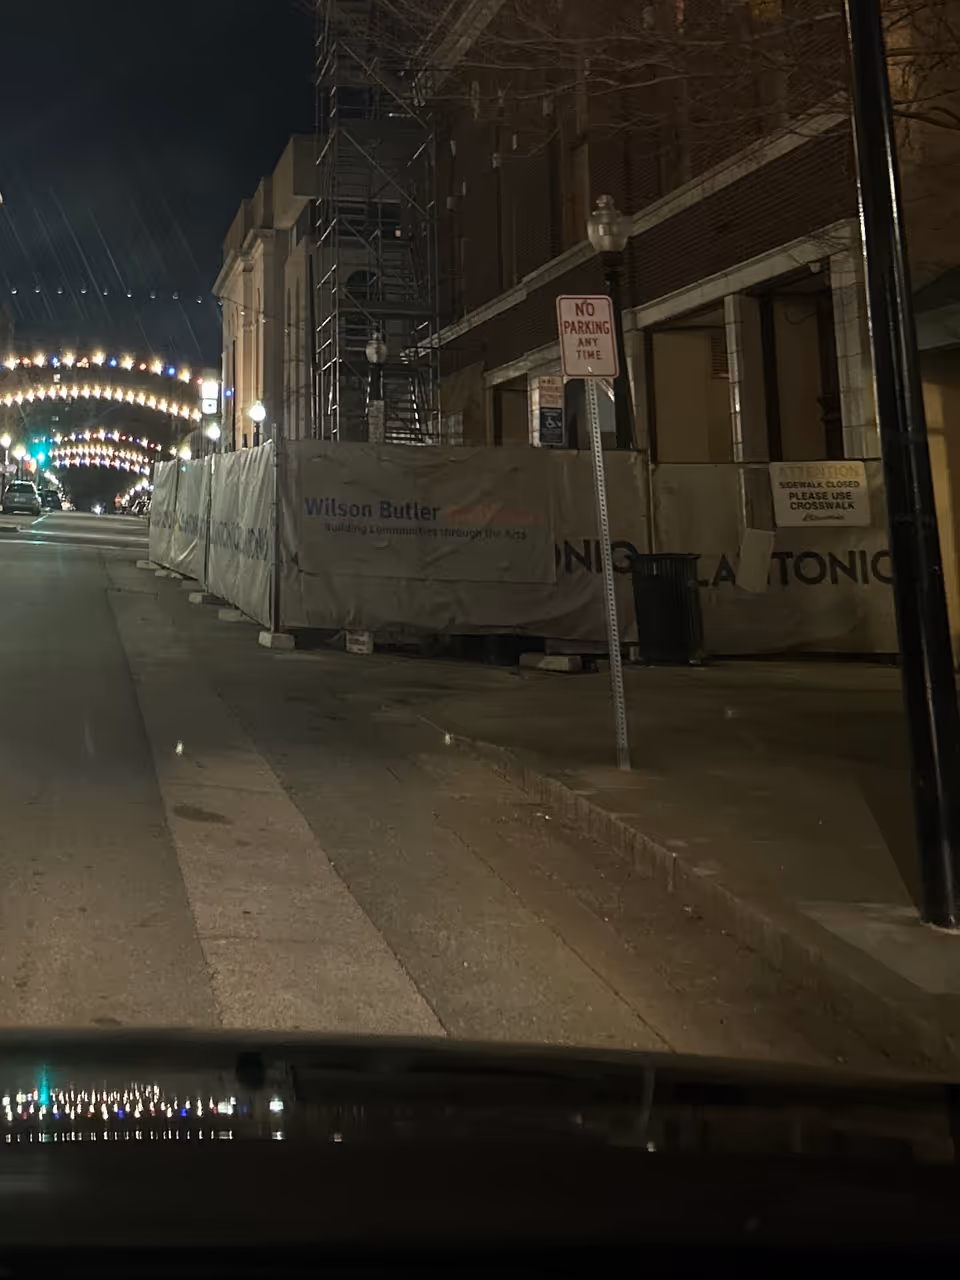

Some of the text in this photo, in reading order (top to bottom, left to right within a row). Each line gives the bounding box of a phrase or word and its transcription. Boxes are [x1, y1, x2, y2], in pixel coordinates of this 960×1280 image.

[575, 302, 595, 317] NO
[563, 320, 610, 335] PARKING
[577, 337, 598, 348] ANY
[576, 350, 603, 360] TIME
[778, 464, 862, 480] ATTENTION
[779, 480, 860, 489] SIDEWALK CLOSED
[789, 491, 853, 501] PLEASE USE
[304, 497, 372, 518] Wilson
[380, 500, 441, 521] Butler
[789, 501, 855, 511] CROSSWALK
